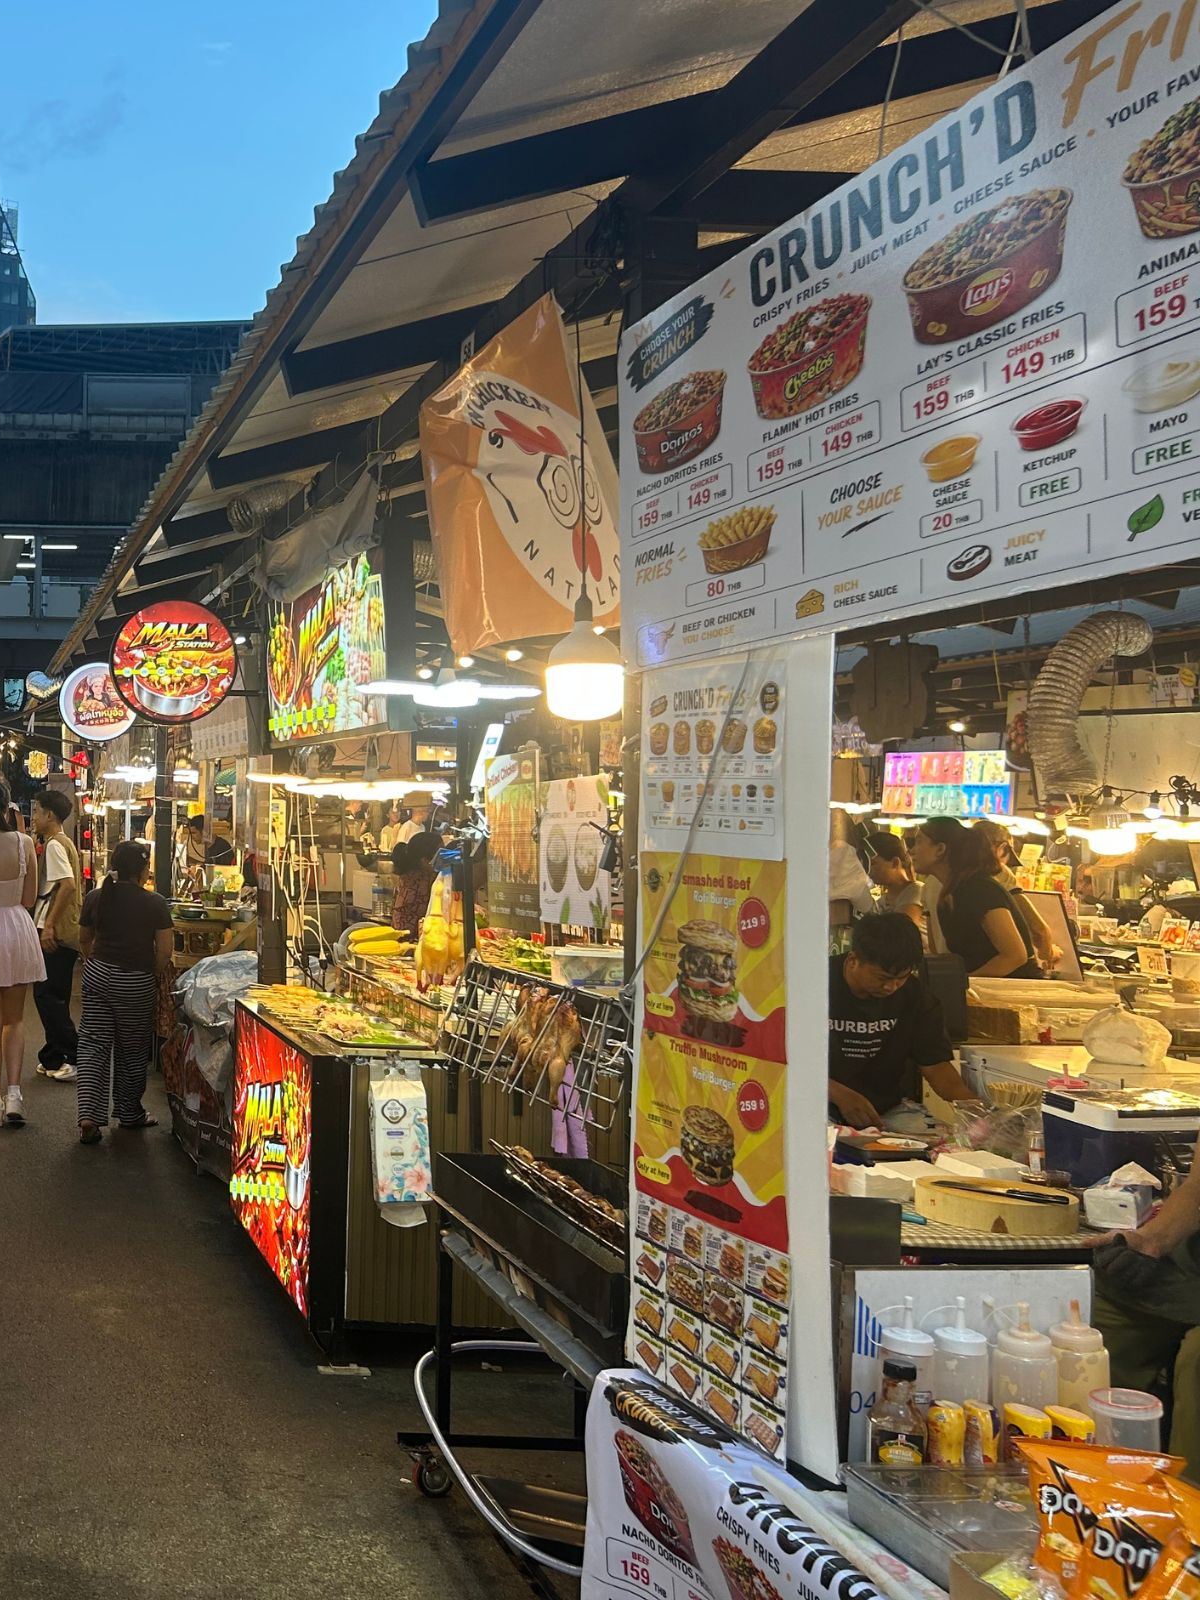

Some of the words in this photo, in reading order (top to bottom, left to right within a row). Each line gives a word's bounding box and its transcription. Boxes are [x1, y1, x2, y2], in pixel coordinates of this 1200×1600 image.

[753, 298, 792, 328] CRISPY
[796, 277, 830, 304] FRIES
[850, 243, 887, 274] JUICY
[893, 219, 930, 247] MEAT
[954, 172, 1015, 214] CHEESE
[1018, 136, 1077, 178] SAUCE
[1106, 90, 1160, 129] YOUR
[1154, 275, 1190, 299] BEEF
[1134, 294, 1186, 332] 159
[640, 328, 672, 360] CHOOSE
[671, 305, 696, 338] YOUR
[957, 322, 1017, 357] CLASSIC
[1022, 300, 1065, 329] FRIES
[642, 324, 695, 380] CRUNCH
[1006, 328, 1060, 359] CHICKEN
[784, 352, 836, 402] Cheetos
[1001, 351, 1044, 385] 149
[1049, 349, 1075, 366] THB
[927, 374, 951, 392] BEEF
[805, 406, 827, 427] HOT
[829, 393, 860, 415] FRIES
[913, 390, 949, 420] 159
[954, 389, 974, 404] THB
[825, 412, 863, 435] CHICKEN
[1149, 412, 1188, 434] MAYO
[660, 423, 704, 454] Doritos
[821, 431, 852, 457] 149
[855, 430, 874, 444] THB
[766, 446, 786, 460] BEEF
[1023, 448, 1077, 473] KETCHUP
[1145, 439, 1193, 466] FREE
[636, 480, 662, 498] NACHO
[663, 465, 698, 486] DORITOS
[699, 453, 724, 472] FRIES
[690, 473, 720, 491] CHICKEN
[756, 458, 785, 483] 159
[787, 459, 804, 471] THB
[687, 488, 711, 510] 149
[713, 489, 727, 499] THB
[830, 472, 884, 504] CHOOSE
[932, 478, 971, 498] CHEESE
[935, 491, 968, 508] SAUCE
[1029, 476, 1070, 500] FREE
[638, 510, 659, 529] 159
[661, 510, 673, 521] THB
[817, 506, 852, 531] YOUR
[856, 485, 904, 516] SAUCE
[932, 513, 952, 531] 20
[1003, 529, 1047, 551] JUICY
[634, 541, 675, 568] NORMAL
[1004, 549, 1039, 567] MEAT
[635, 558, 673, 587] FRIES
[707, 579, 725, 598] 80
[727, 581, 742, 592] THB
[833, 579, 859, 595] RICH
[833, 593, 867, 609] CHEESE
[868, 584, 899, 601] SAUCE
[682, 620, 702, 634] BEEF
[703, 617, 715, 628] OR
[717, 607, 756, 626] CHICKEN
[128, 621, 210, 649] MALA
[173, 640, 216, 649] STATION
[726, 874, 752, 891] Beef
[740, 917, 758, 931] 219
[699, 1047, 748, 1072] Mushroom
[238, 1082, 282, 1158] MALA
[621, 1523, 656, 1551] NACHO
[657, 1544, 694, 1578] DORITOS
[716, 1505, 750, 1546] CRISPY
[753, 1538, 781, 1576] FRIES
[631, 1551, 650, 1566] BEEF
[620, 1559, 651, 1586] 159
[653, 1582, 668, 1599] THB
